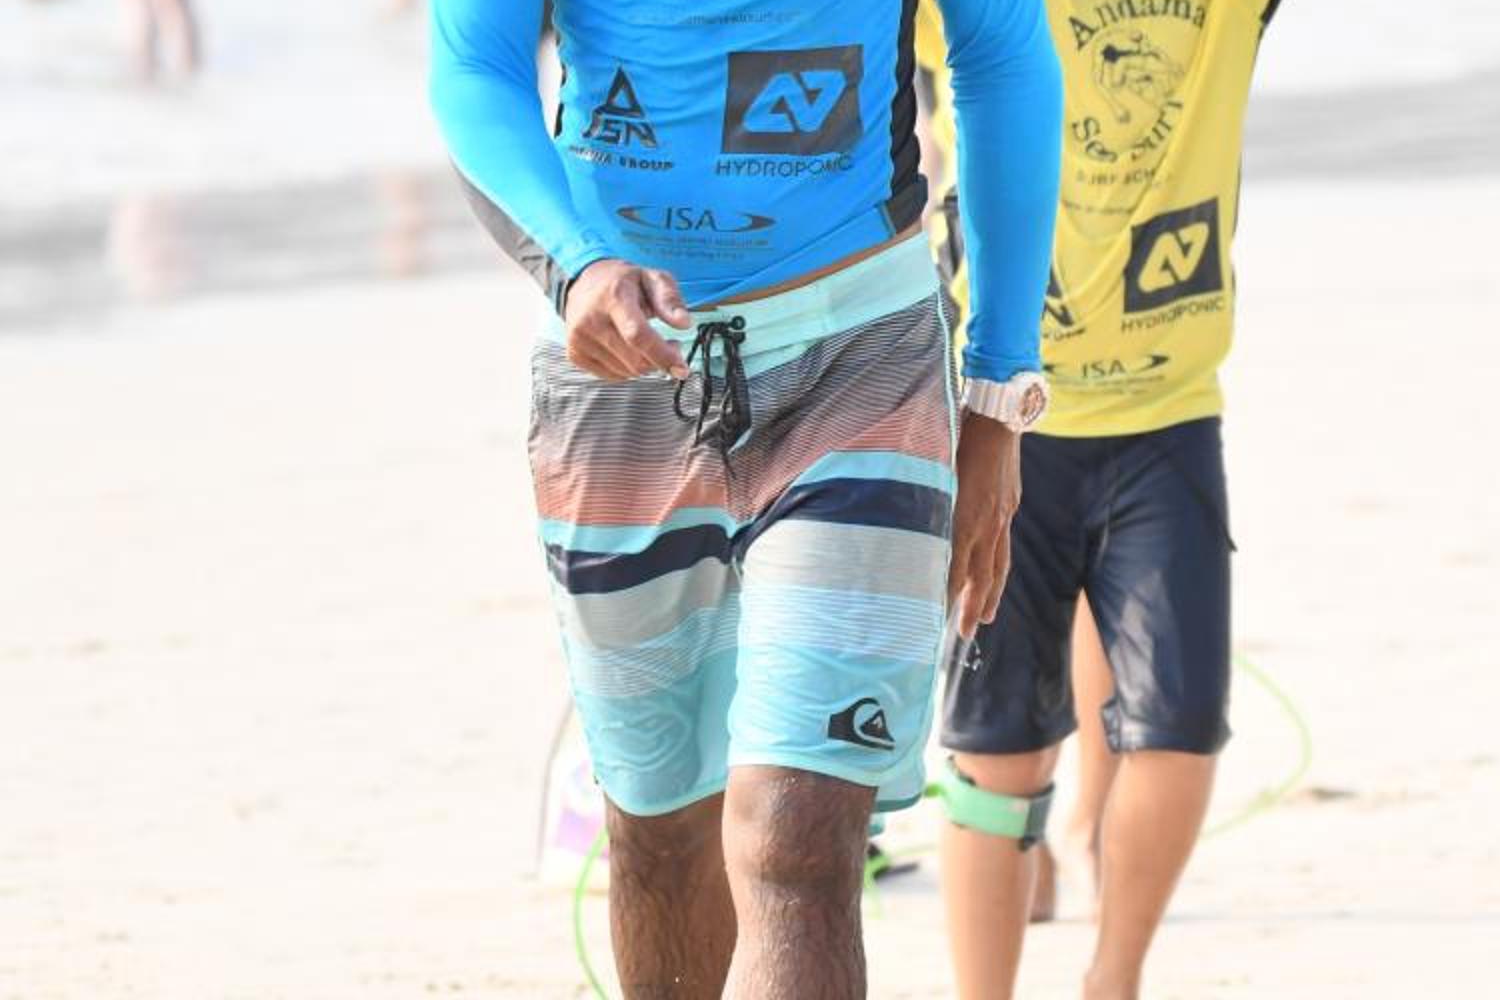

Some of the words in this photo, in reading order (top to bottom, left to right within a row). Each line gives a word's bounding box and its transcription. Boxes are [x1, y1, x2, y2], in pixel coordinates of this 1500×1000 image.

[713, 154, 854, 177] HYDROPONIC
[663, 206, 718, 232] ISA
[1120, 296, 1226, 335] HYDROPONIC
[1082, 359, 1127, 379] ISA
